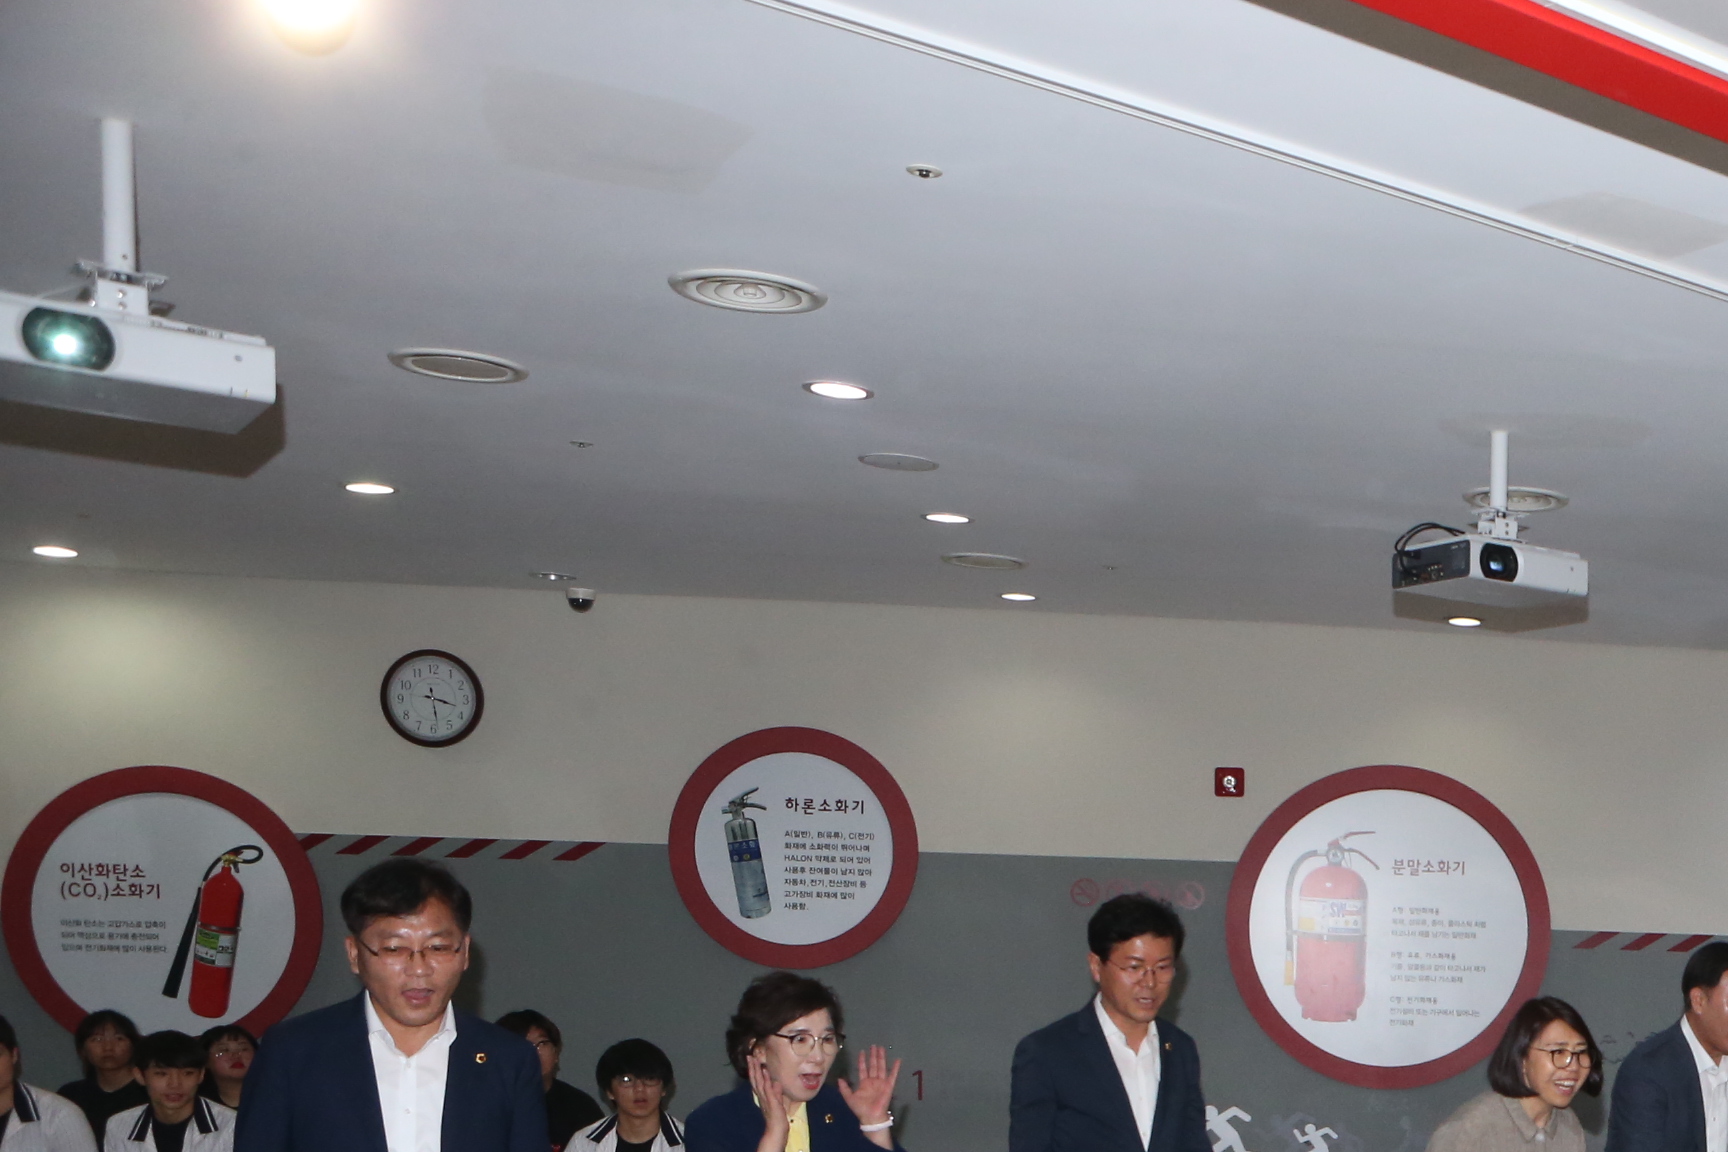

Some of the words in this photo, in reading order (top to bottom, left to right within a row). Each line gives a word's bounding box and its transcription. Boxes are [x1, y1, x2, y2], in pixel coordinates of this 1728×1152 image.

[413, 669, 421, 678] 11
[428, 664, 439, 674] 12
[449, 669, 452, 678] 1
[400, 680, 411, 690] 10
[458, 681, 464, 690] 2
[397, 695, 404, 704] 9
[463, 695, 469, 705] 3
[403, 710, 409, 720] 8
[458, 711, 463, 720] 4
[415, 721, 421, 731] 7
[431, 724, 437, 734] 6
[446, 720, 452, 730] 5
[784, 797, 866, 815] 하론소화기
[60, 863, 146, 881] 이산화탄소
[1392, 859, 1465, 876] 분말소화기
